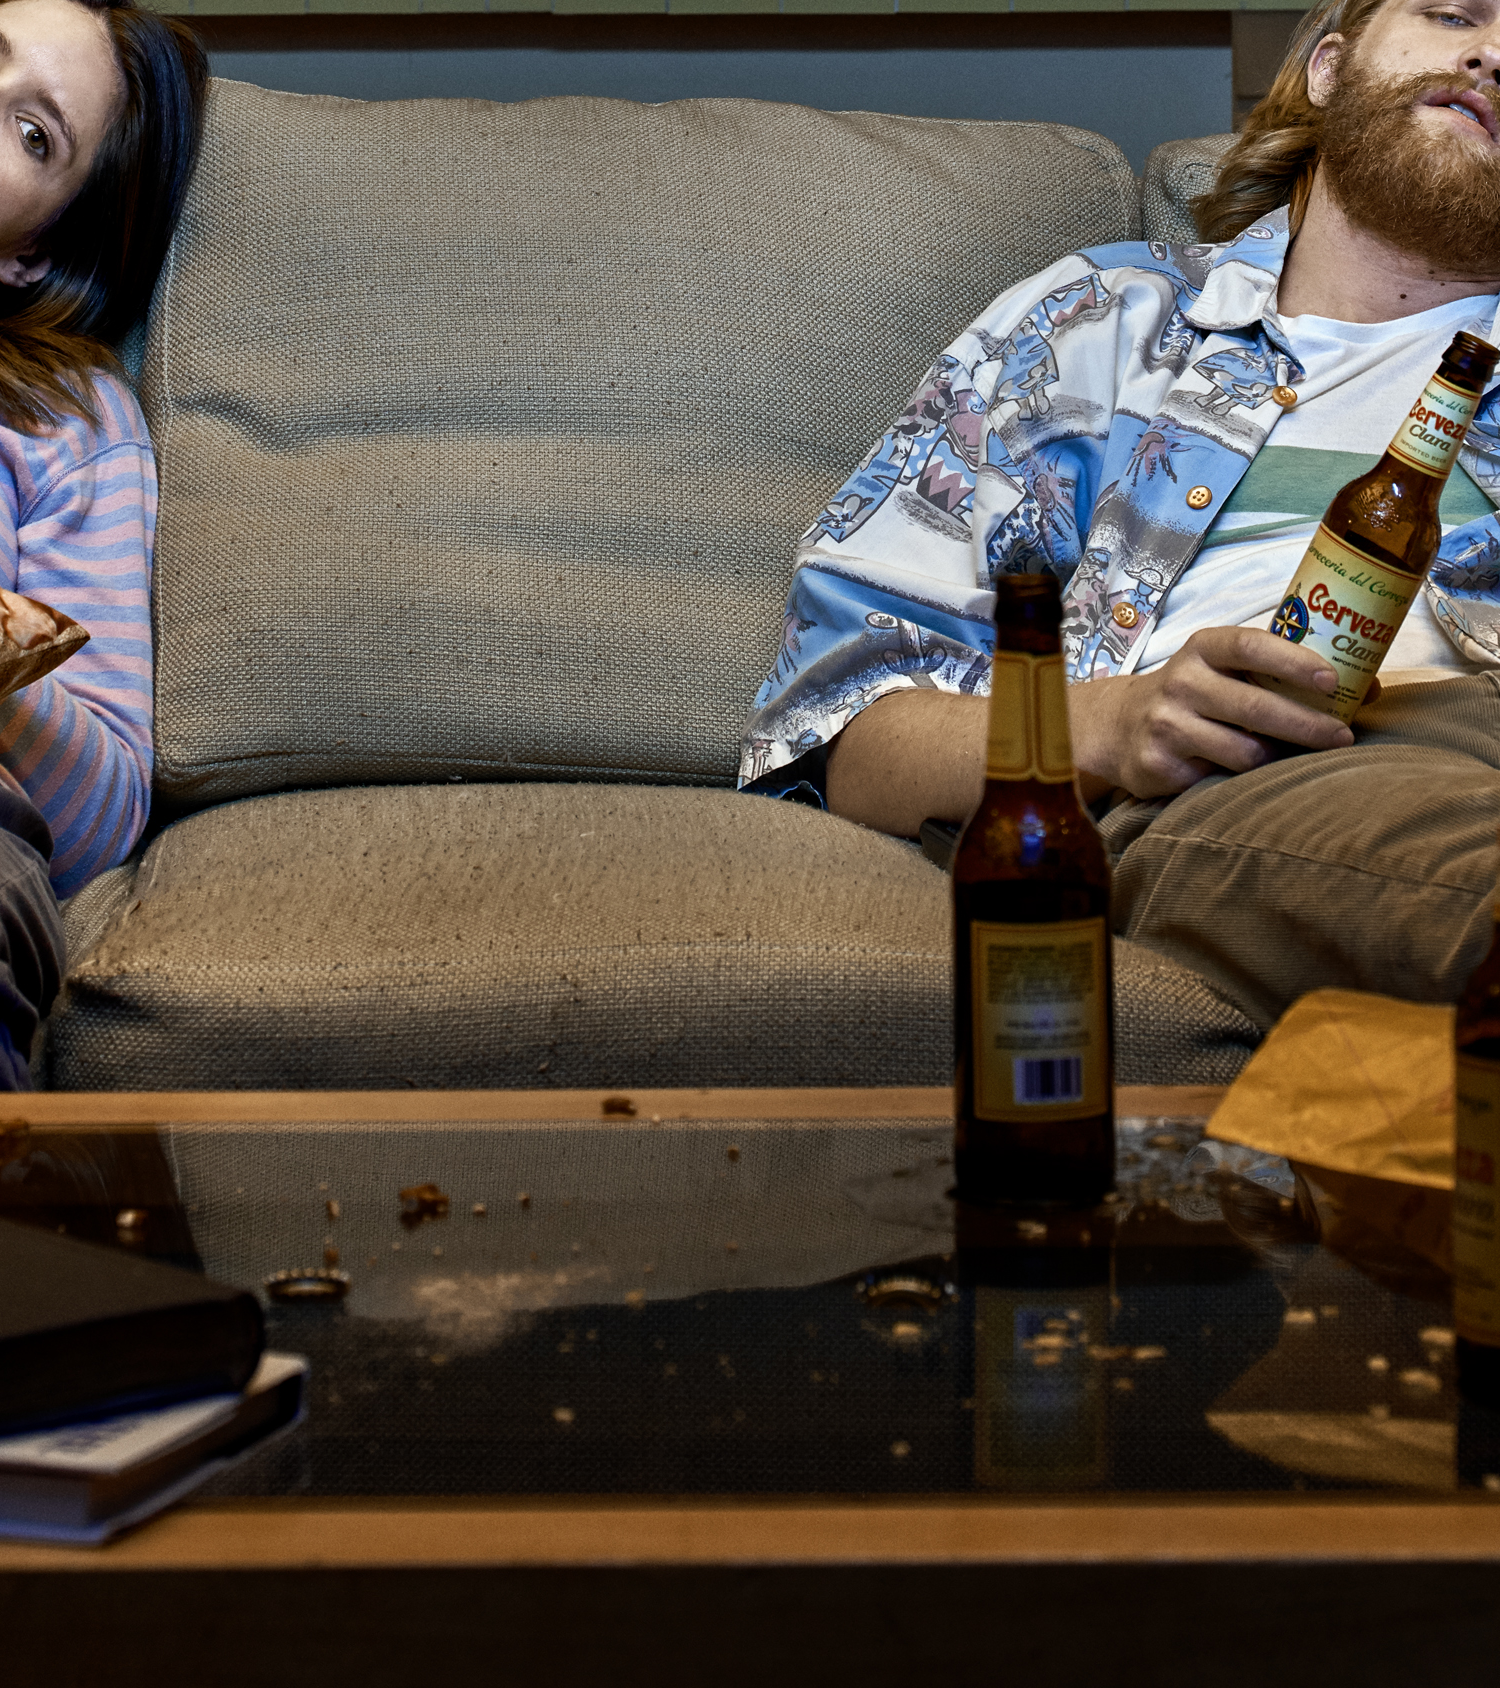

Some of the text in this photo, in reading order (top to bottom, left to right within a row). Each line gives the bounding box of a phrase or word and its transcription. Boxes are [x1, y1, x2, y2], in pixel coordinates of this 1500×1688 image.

[1400, 438, 1430, 459] IMPORTED
[1409, 424, 1451, 452] Clara
[1349, 572, 1372, 587] del
[1307, 582, 1394, 644] Cerveza
[1331, 634, 1380, 665] Clara
[1331, 655, 1362, 671] IMPORTED
